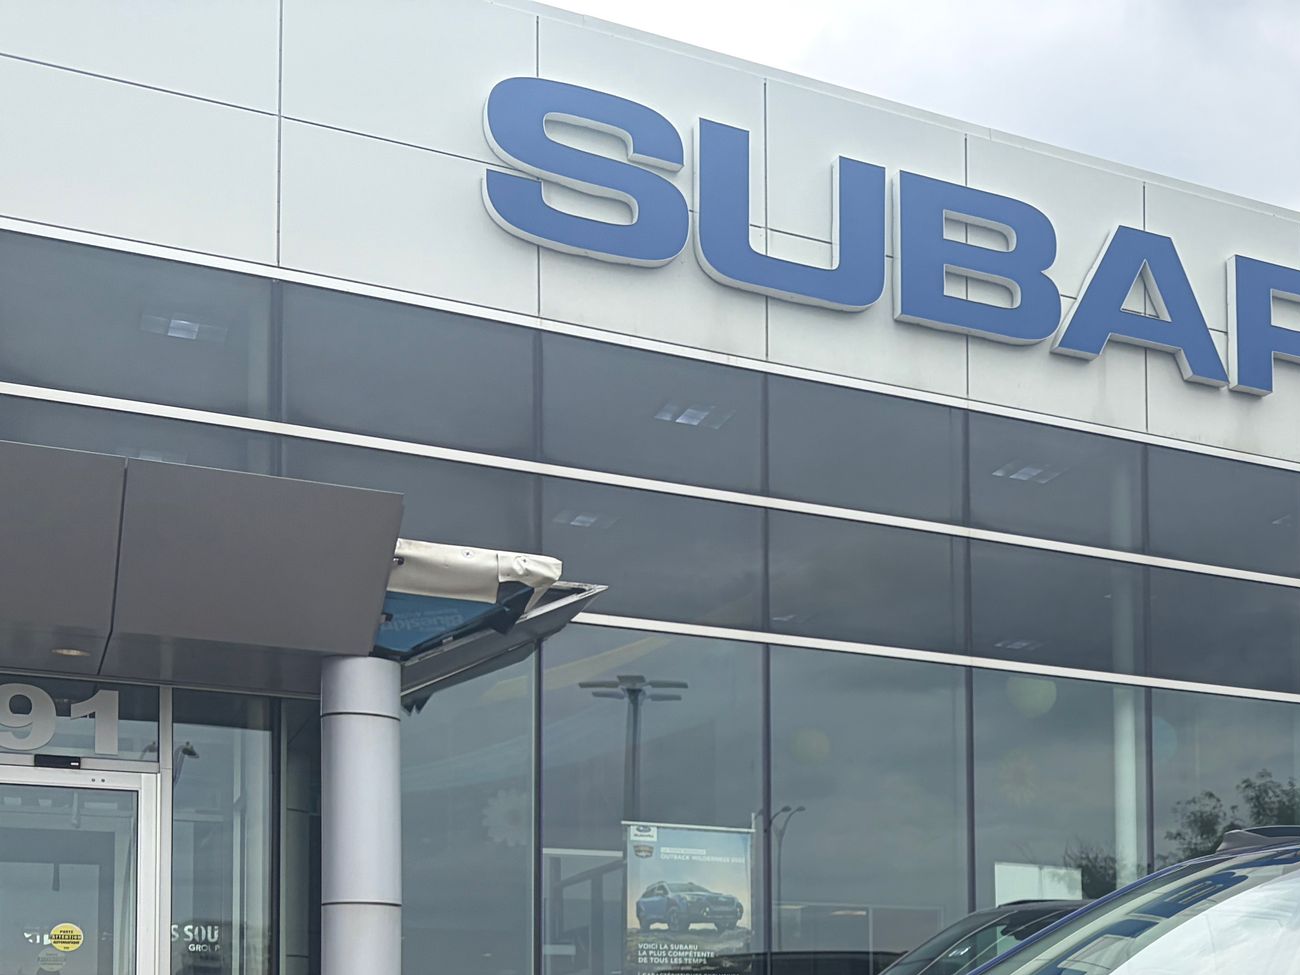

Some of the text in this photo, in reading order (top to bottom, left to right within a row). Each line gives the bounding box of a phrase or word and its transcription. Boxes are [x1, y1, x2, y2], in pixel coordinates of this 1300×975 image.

[0, 683, 119, 755] 91
[670, 943, 698, 951] SUBARU
[668, 950, 715, 958] COMPÉTENTE
